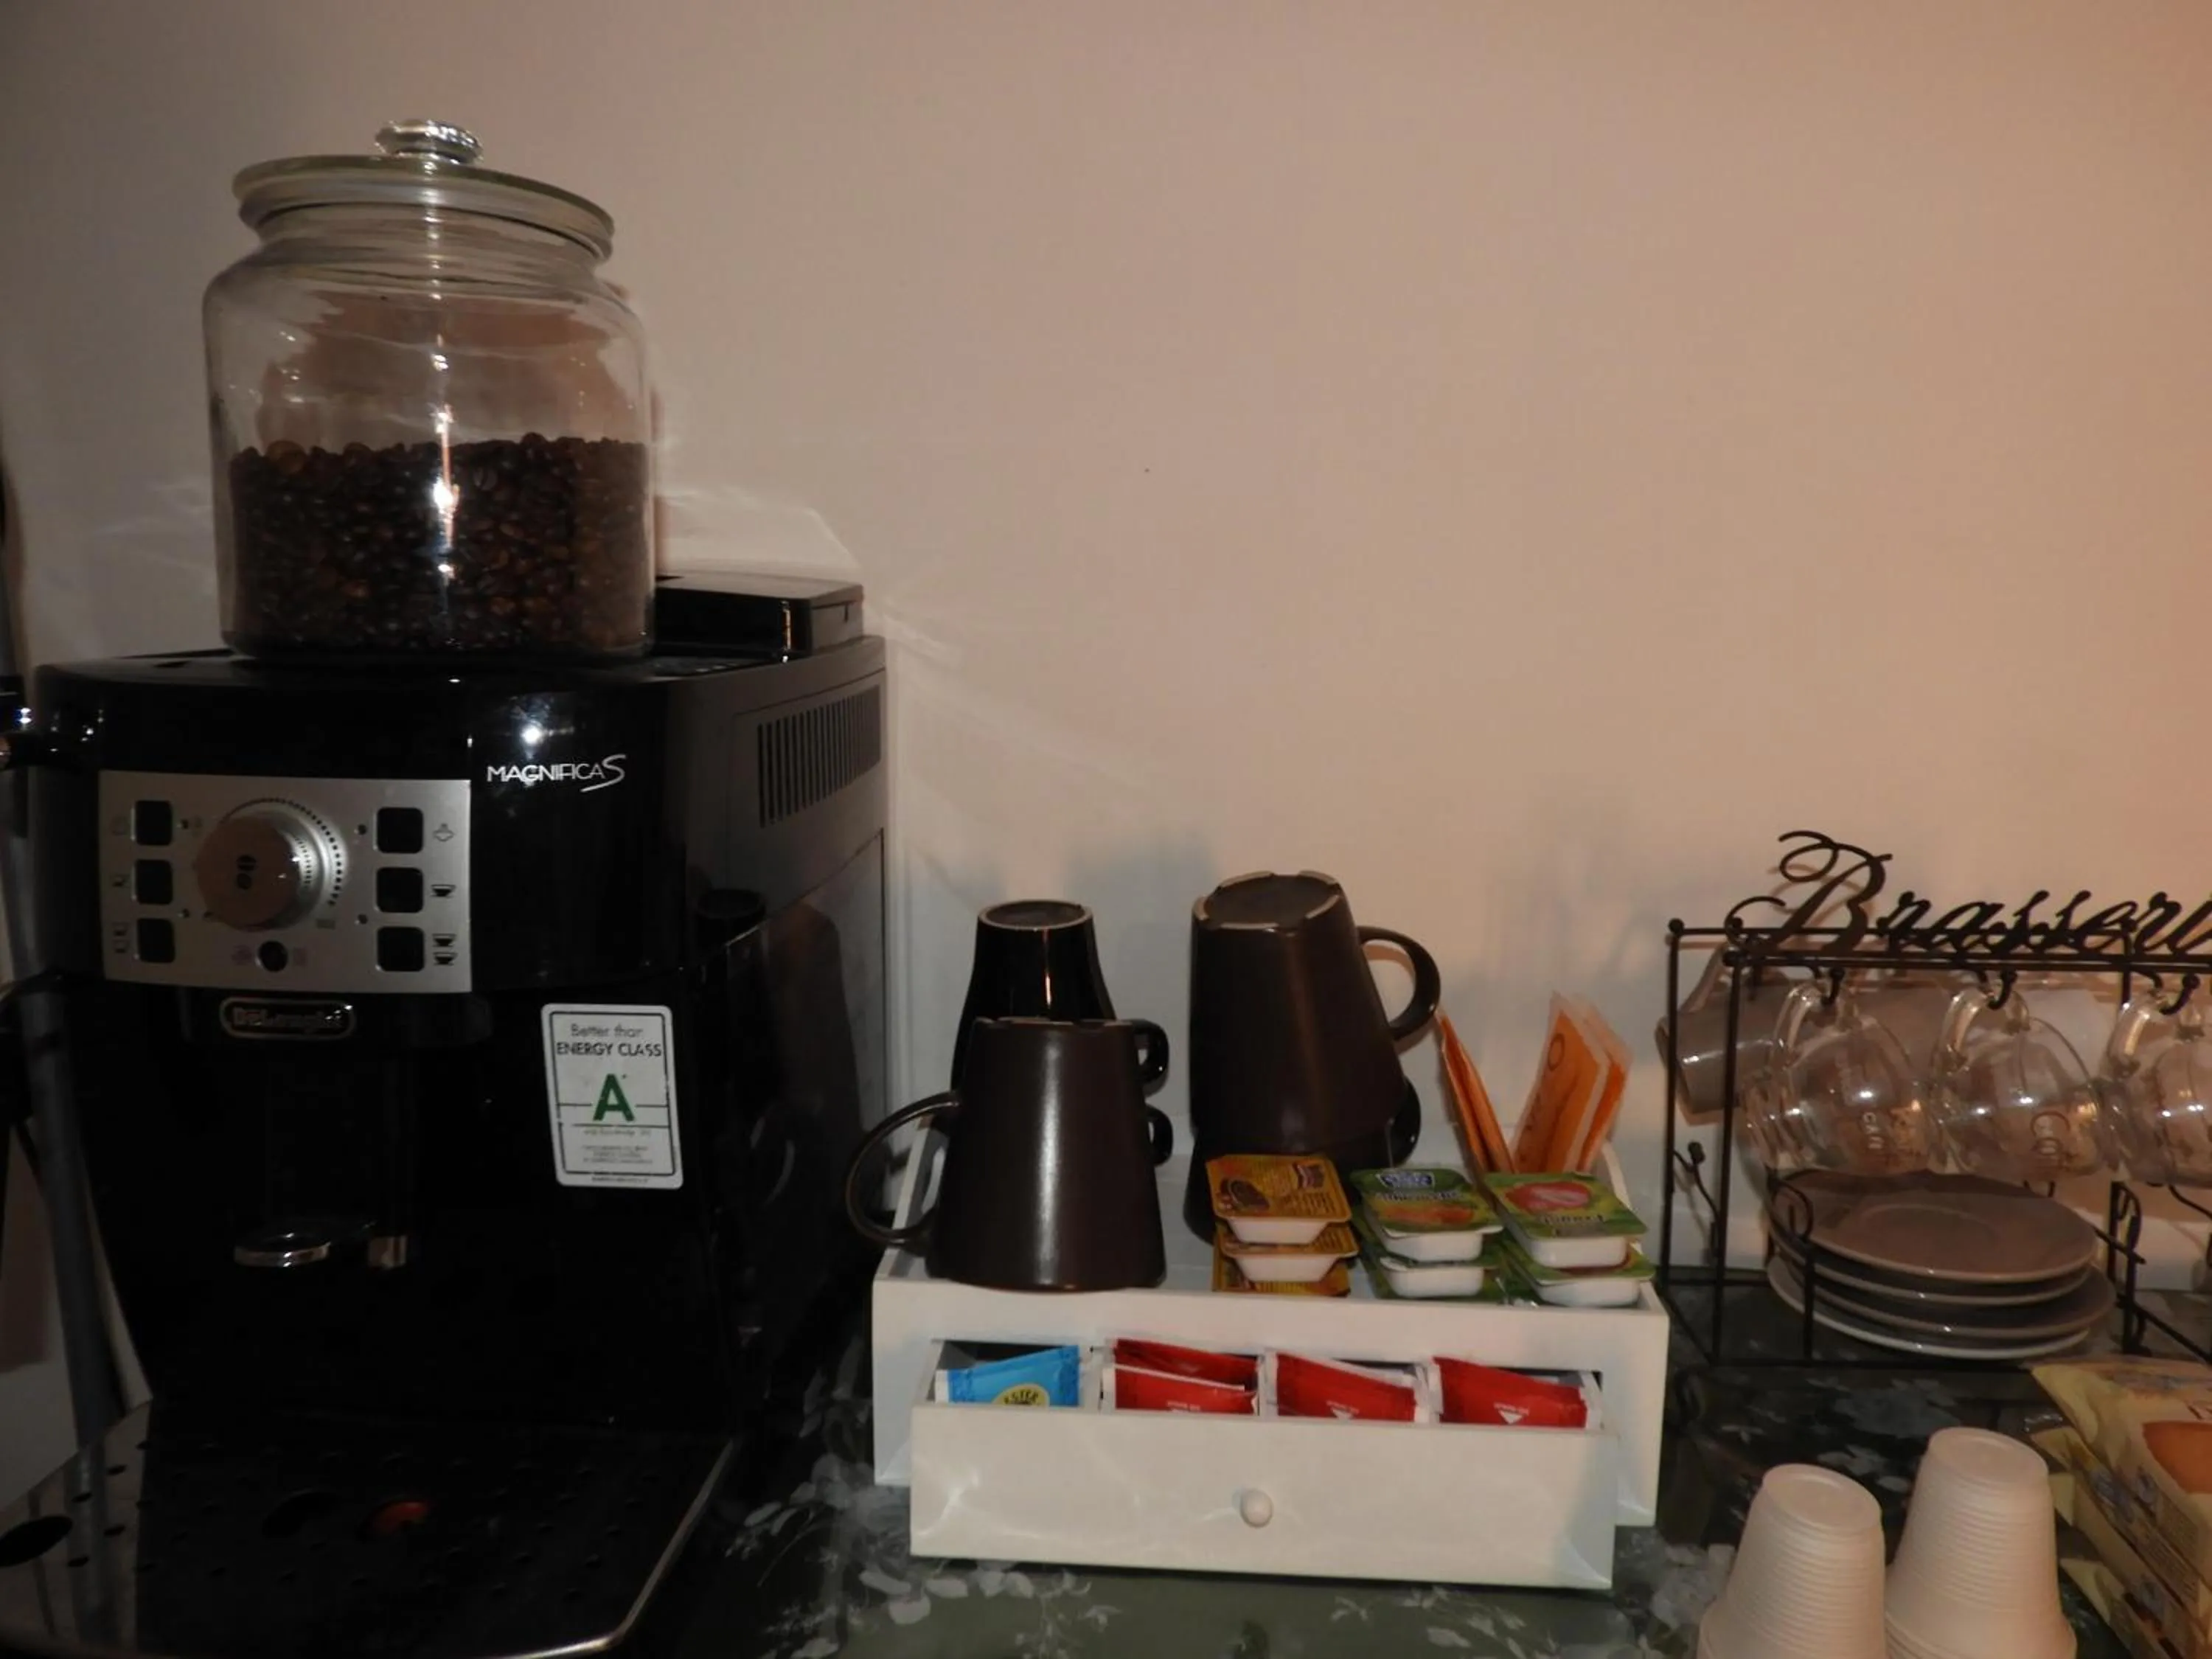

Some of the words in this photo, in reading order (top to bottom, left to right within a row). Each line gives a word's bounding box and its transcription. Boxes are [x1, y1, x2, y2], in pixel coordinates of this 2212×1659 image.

[571, 1023, 610, 1037] Better
[614, 1023, 644, 1037] than
[557, 1042, 613, 1057] ENERGY
[618, 1043, 662, 1057] CLASS
[592, 1073, 635, 1121] A
